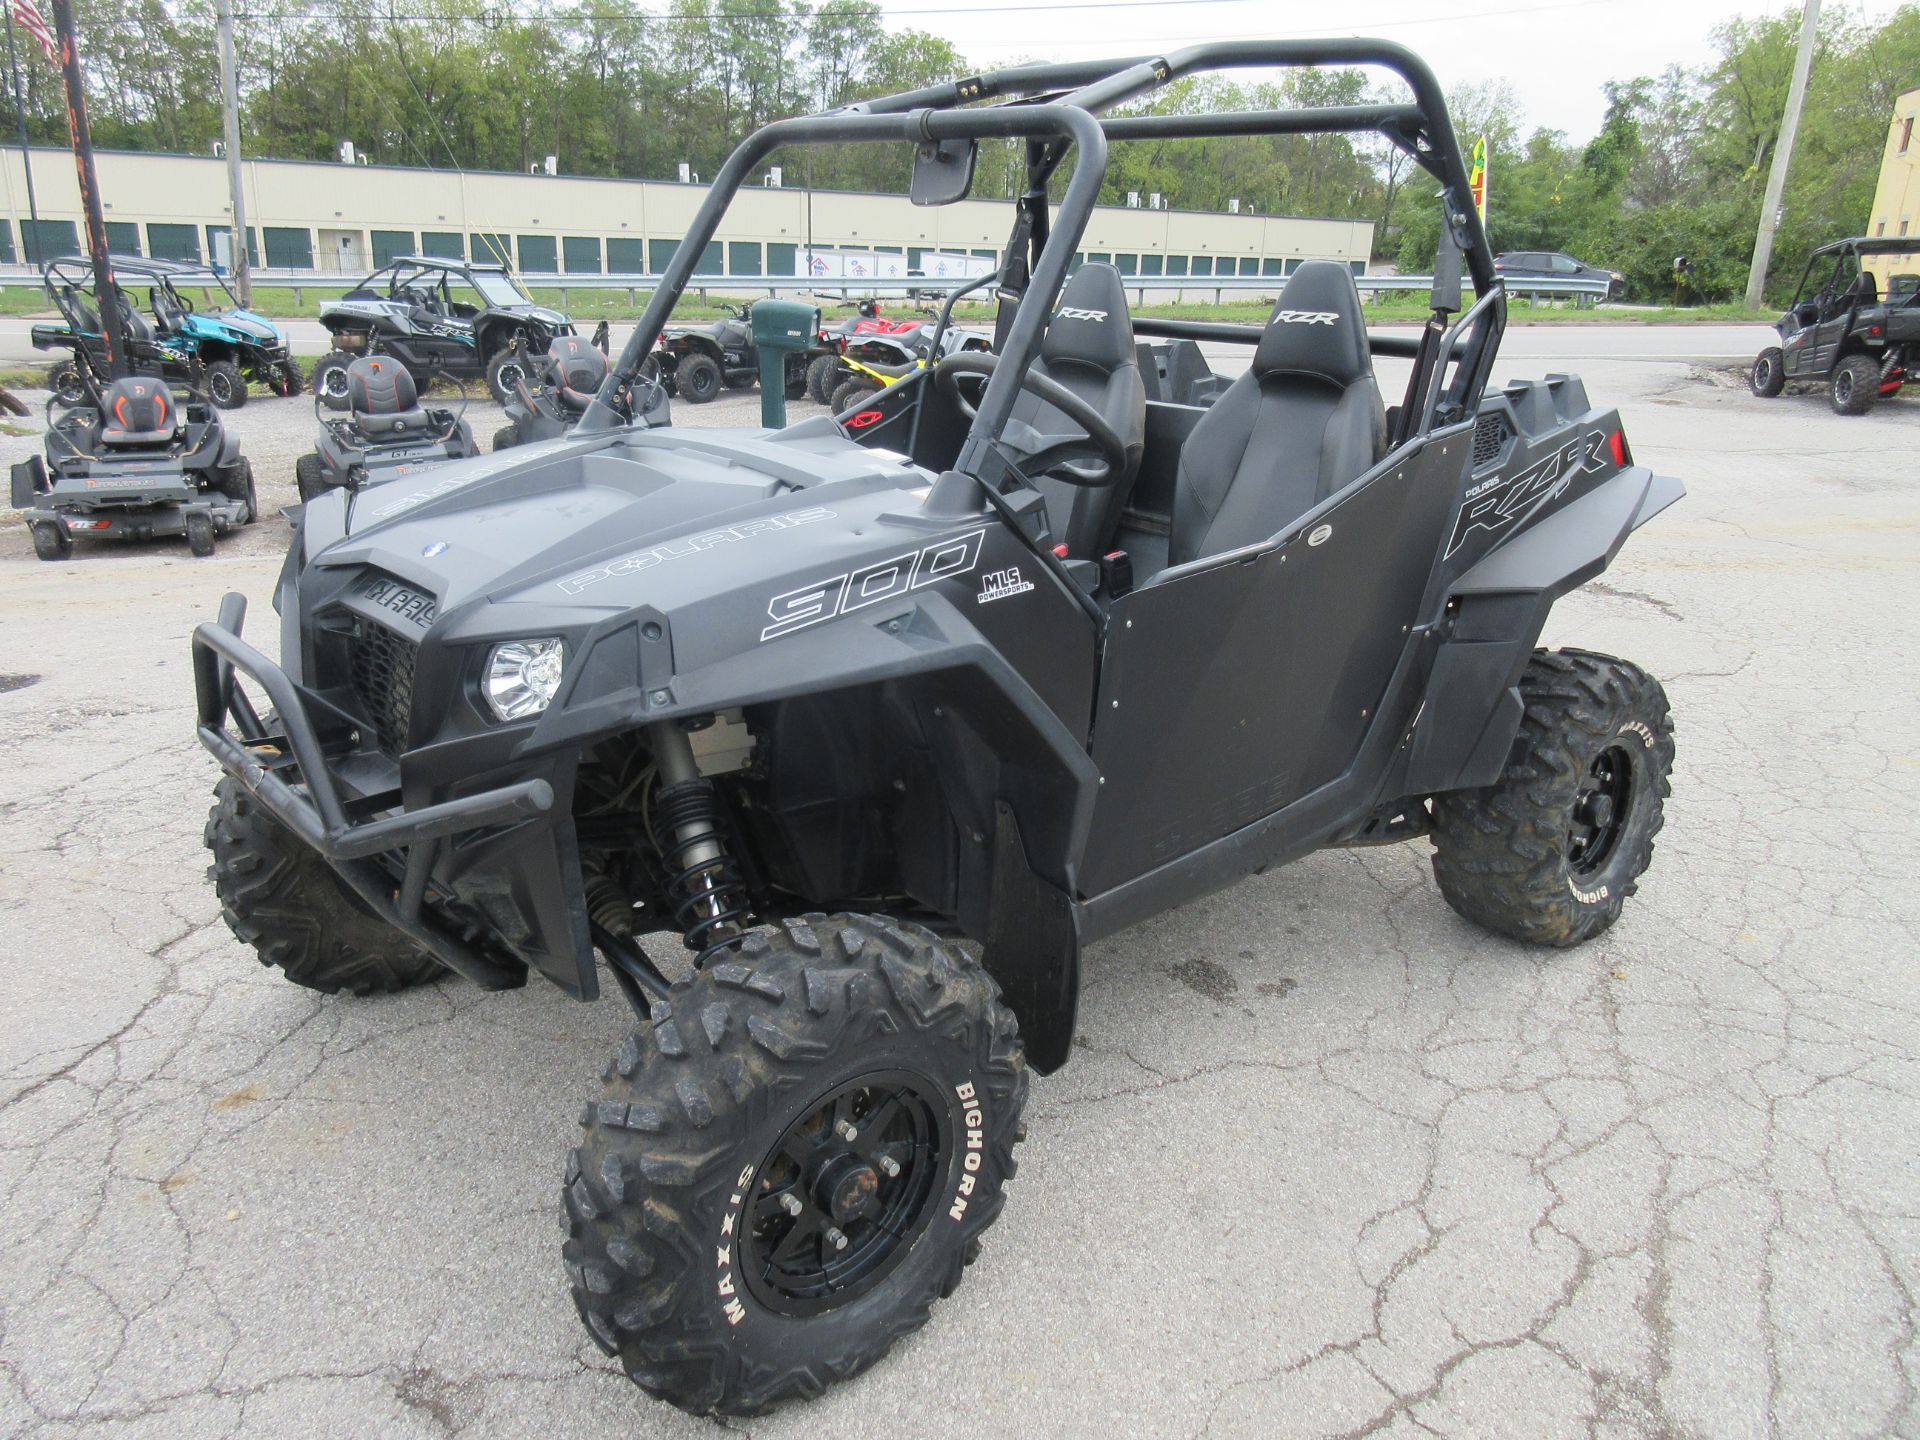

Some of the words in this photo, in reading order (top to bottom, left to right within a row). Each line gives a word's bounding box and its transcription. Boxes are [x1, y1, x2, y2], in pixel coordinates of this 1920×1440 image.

[1056, 306, 1109, 323] RZR
[1272, 309, 1340, 326] RZR
[1442, 429, 1608, 562] RZR
[1465, 475, 1501, 498] POLARIS
[557, 507, 839, 596] POLARIS
[759, 529, 986, 642] 900
[978, 582, 1030, 603] POWERSPORTS
[982, 567, 1021, 592] MLS
[354, 575, 436, 629] OLARIS
[1616, 720, 1654, 749] MAXXIS
[949, 1080, 983, 1222] BIGHORN
[716, 1163, 755, 1327] MAXXIS
